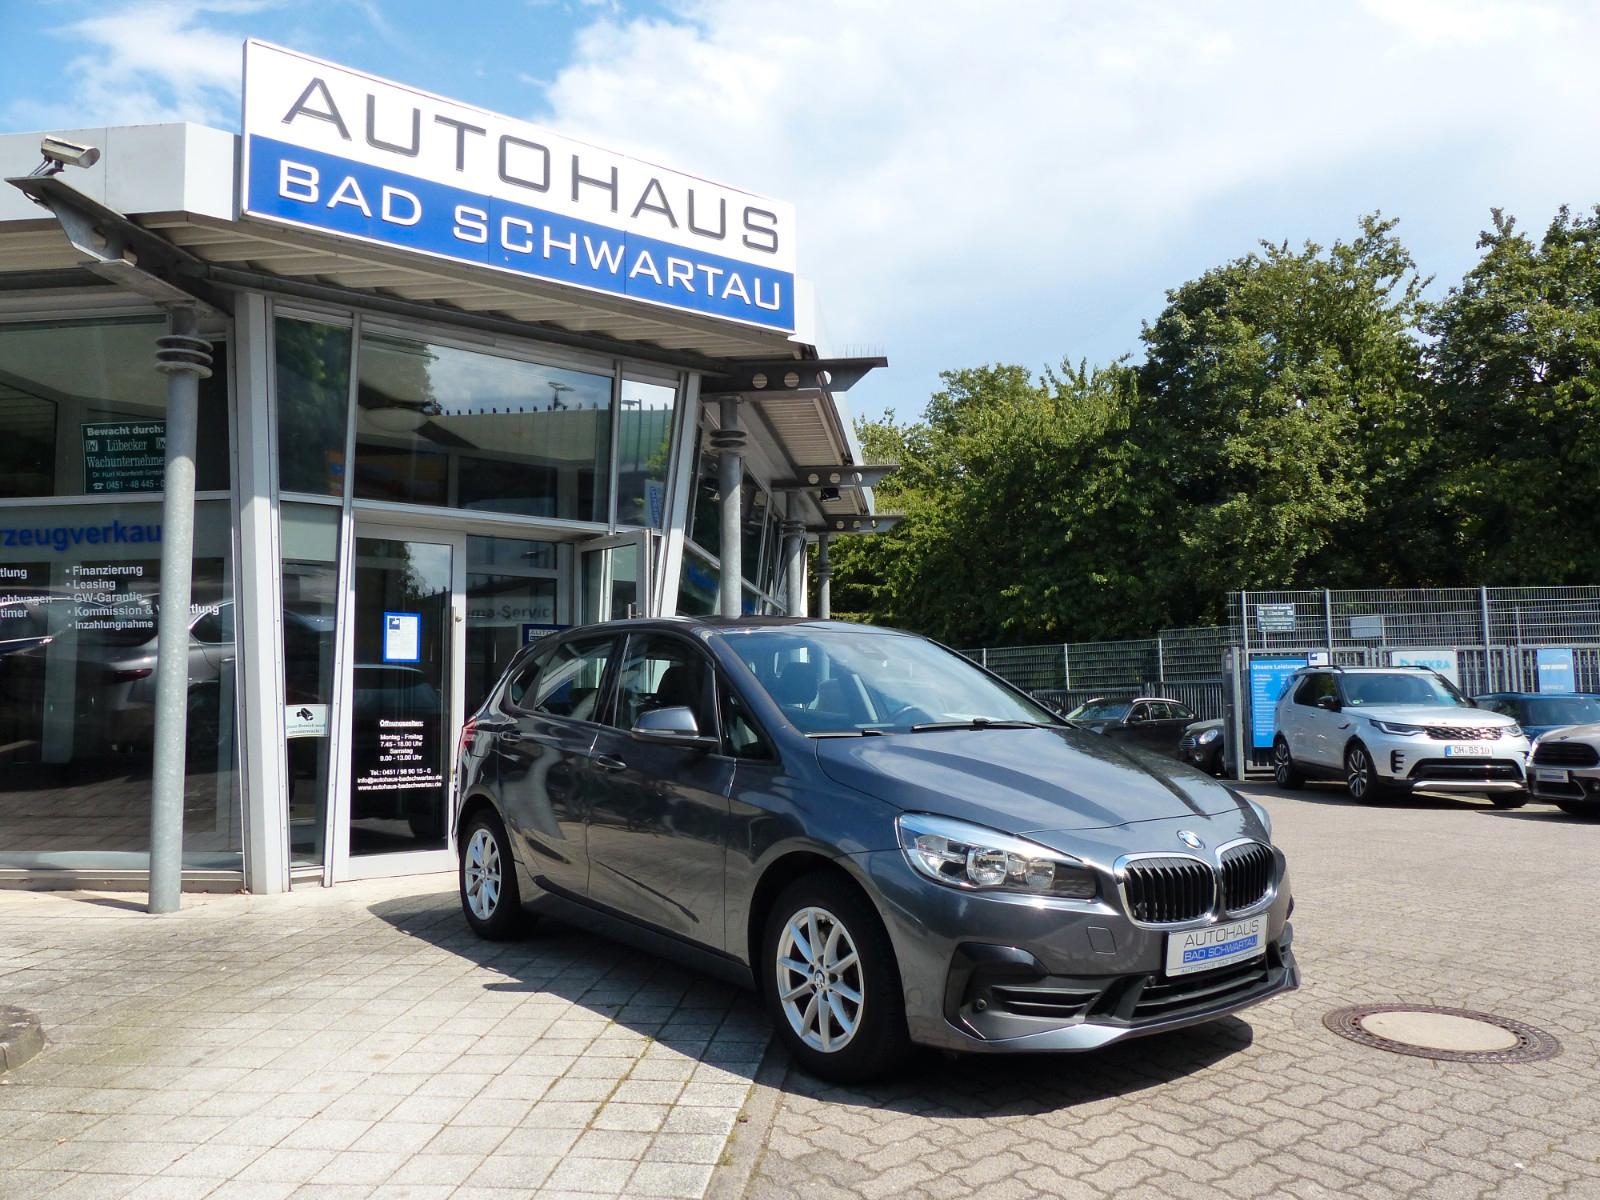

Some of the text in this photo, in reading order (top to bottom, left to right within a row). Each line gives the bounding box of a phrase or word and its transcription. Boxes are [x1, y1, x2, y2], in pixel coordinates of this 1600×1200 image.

[281, 77, 778, 254] AUTOHAUS
[279, 159, 780, 310] BAD SCHWARTAU
[87, 425, 164, 436] Bewacht durch:
[105, 439, 148, 452] Lübecker
[86, 455, 166, 468] Wachunternehme
[106, 481, 123, 489] 0451
[141, 480, 154, 488] 445
[73, 566, 144, 577] Finanzierung
[74, 580, 116, 591] Leasing
[74, 593, 143, 602] GW-Garantie
[75, 606, 142, 616] Kommission
[146, 606, 154, 615] &
[75, 620, 154, 630] Inzahlungnahme
[1184, 920, 1259, 948] AUTOHAUS
[1184, 935, 1257, 961] BAD SCHWARTAU
